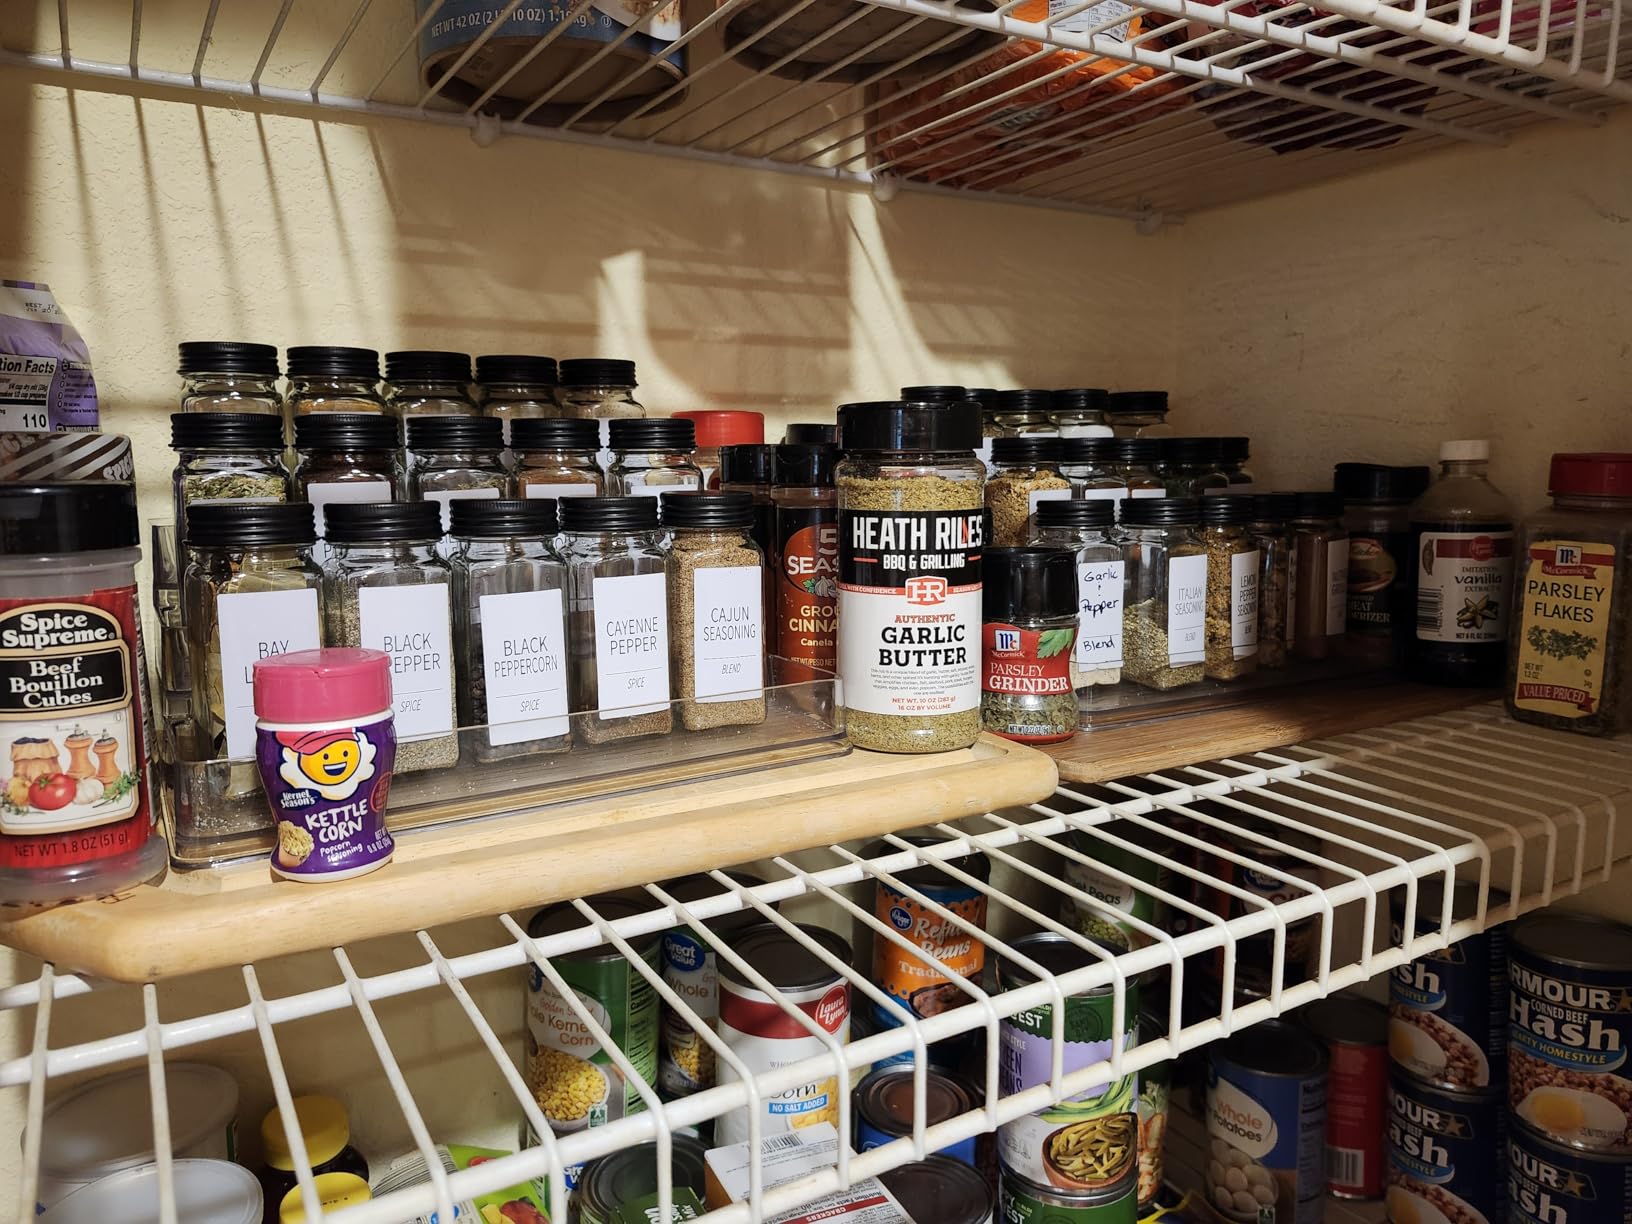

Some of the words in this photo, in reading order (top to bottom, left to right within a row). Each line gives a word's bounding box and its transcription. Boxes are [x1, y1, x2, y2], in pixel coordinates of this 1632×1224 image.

[443, 18, 455, 32] WT
[456, 14, 467, 29] 42
[469, 12, 481, 26] OZ
[527, 8, 545, 23] OZ)
[25, 360, 55, 374] Facts
[23, 414, 46, 428] 110
[853, 516, 926, 550] HEATH
[936, 515, 982, 550] RILES
[883, 554, 906, 571] BBQ
[909, 554, 917, 569] &
[920, 553, 965, 570] GRILLING
[1544, 565, 1589, 575] McCormick
[1084, 565, 1118, 582] Garlic
[1240, 574, 1256, 588] LEMON
[1455, 573, 1502, 584] vanilla
[1178, 586, 1202, 600] ITALIAN
[1240, 587, 1256, 602] PEPPER
[1528, 580, 1605, 602] PARSLEY
[711, 606, 749, 623] CAJUN
[1080, 598, 1119, 618] Pepper
[1175, 600, 1204, 616] SEASONING
[1352, 601, 1372, 612] EAT
[1535, 602, 1594, 622] FLAKES
[20, 608, 88, 633] Spice
[606, 616, 659, 637] CAYENNE
[895, 614, 955, 623] AUTHENTIC
[2, 626, 107, 650] Supreme
[703, 624, 756, 642] SEASONING
[800, 638, 833, 646] Canela
[882, 624, 965, 644] GARLIC
[259, 640, 289, 660] BAY
[384, 633, 431, 653] BLACK
[504, 636, 548, 657] BLACK
[610, 636, 657, 655] PEPPER
[1083, 635, 1115, 651] Blend
[389, 653, 441, 674] EPPER
[494, 654, 558, 678] PEPPERCORN
[879, 647, 966, 667] BUTTER
[30, 657, 82, 677] Beef
[722, 663, 741, 674] BLEND
[991, 662, 1045, 676] PARSLEY
[9, 673, 103, 694] Bouillon
[627, 677, 645, 690] SPICE
[989, 675, 1069, 692] GRINDER
[23, 691, 92, 708] Cubes
[1523, 685, 1552, 699] VALUE
[1553, 687, 1586, 704] PRICED
[400, 699, 422, 713] SPICE
[520, 699, 540, 712] SPICE
[305, 799, 368, 830] KETTLE
[318, 816, 363, 844] CORN
[15, 842, 34, 857] NET
[39, 841, 58, 856] WT
[61, 839, 78, 854] 1.8
[82, 836, 97, 850] OZ
[100, 833, 114, 848] (51
[320, 841, 351, 857] Popcorn
[327, 843, 364, 862] seasoning
[1089, 886, 1121, 904] Peas
[665, 936, 696, 958] Great
[920, 941, 970, 960] Beans
[667, 976, 708, 997] Whole
[1392, 962, 1440, 994] sh
[1511, 964, 1612, 1010] RMOUR
[819, 995, 844, 1017] Laura
[1531, 998, 1564, 1020] CORNED
[1566, 1007, 1588, 1025] BEEF
[549, 1014, 588, 1032] Kerne
[825, 1008, 846, 1025] Lynn
[1510, 989, 1620, 1052] Hash
[560, 1032, 593, 1045] Corn
[1011, 1035, 1026, 1050] STYLE
[1540, 1043, 1607, 1065] HOMESTYLE
[772, 1103, 783, 1112] NO
[785, 1103, 802, 1112] SALT
[803, 1097, 825, 1110] ADDED
[1395, 1094, 1440, 1130] OUR
[1213, 1111, 1262, 1142] Potatoes
[1512, 1144, 1560, 1188] OUR
[811, 1196, 835, 1207] Calories
[836, 1196, 854, 1206] Facts
[855, 1191, 882, 1201] Nutrition
[682, 1204, 698, 1218] Mix
[806, 1206, 846, 1222] CRACKERS
